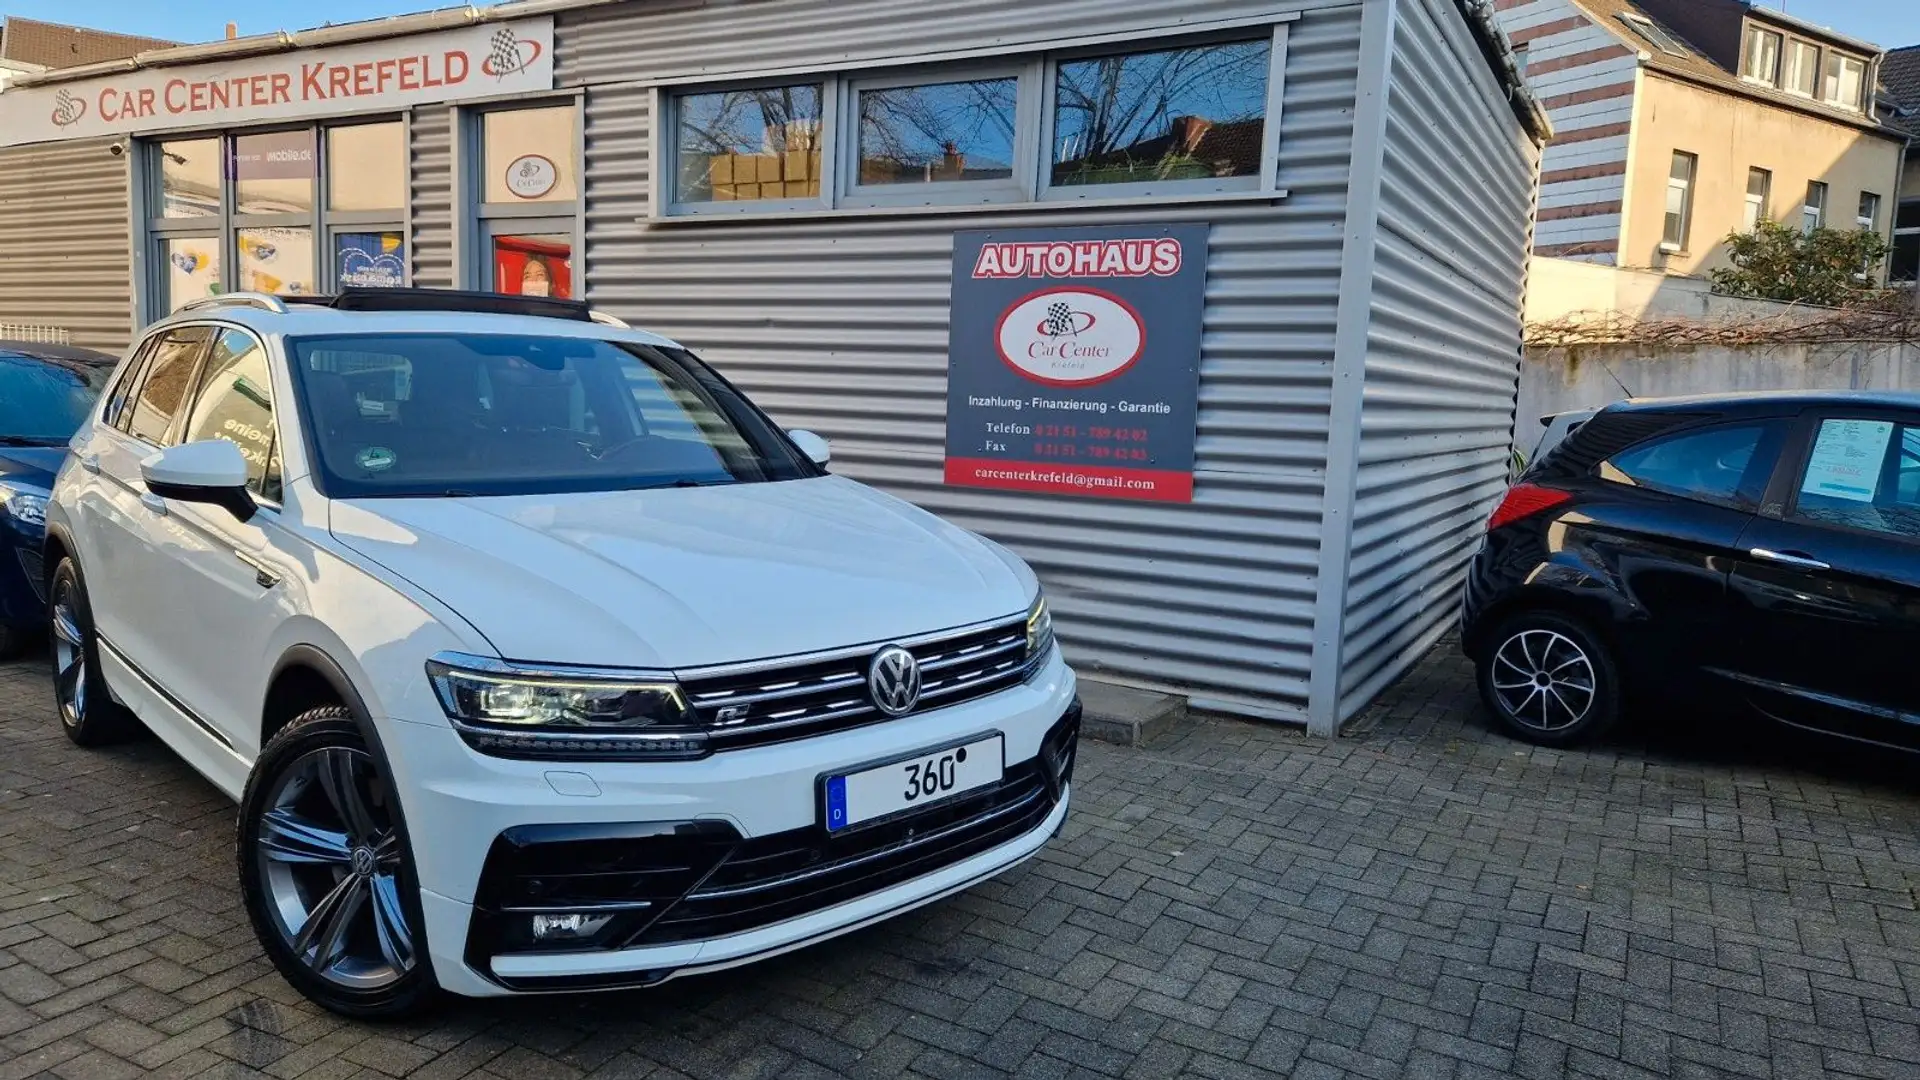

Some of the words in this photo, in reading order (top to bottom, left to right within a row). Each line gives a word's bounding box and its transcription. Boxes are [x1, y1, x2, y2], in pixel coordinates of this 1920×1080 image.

[98, 87, 155, 122] CAR
[164, 72, 291, 114] CENTER
[301, 50, 469, 101] KREFELD
[972, 238, 1182, 279] AUTOHAUS
[1028, 341, 1054, 358] Car
[1059, 342, 1110, 358] Center
[969, 396, 1022, 409] Inzahlung
[1032, 398, 1107, 413] Finanzierung
[1119, 401, 1170, 414] Garantie
[986, 423, 1030, 434] Telefon
[985, 441, 1006, 451] Fax
[976, 468, 1154, 490] carcenterkrefeld@gmail.com
[834, 808, 841, 819] D
